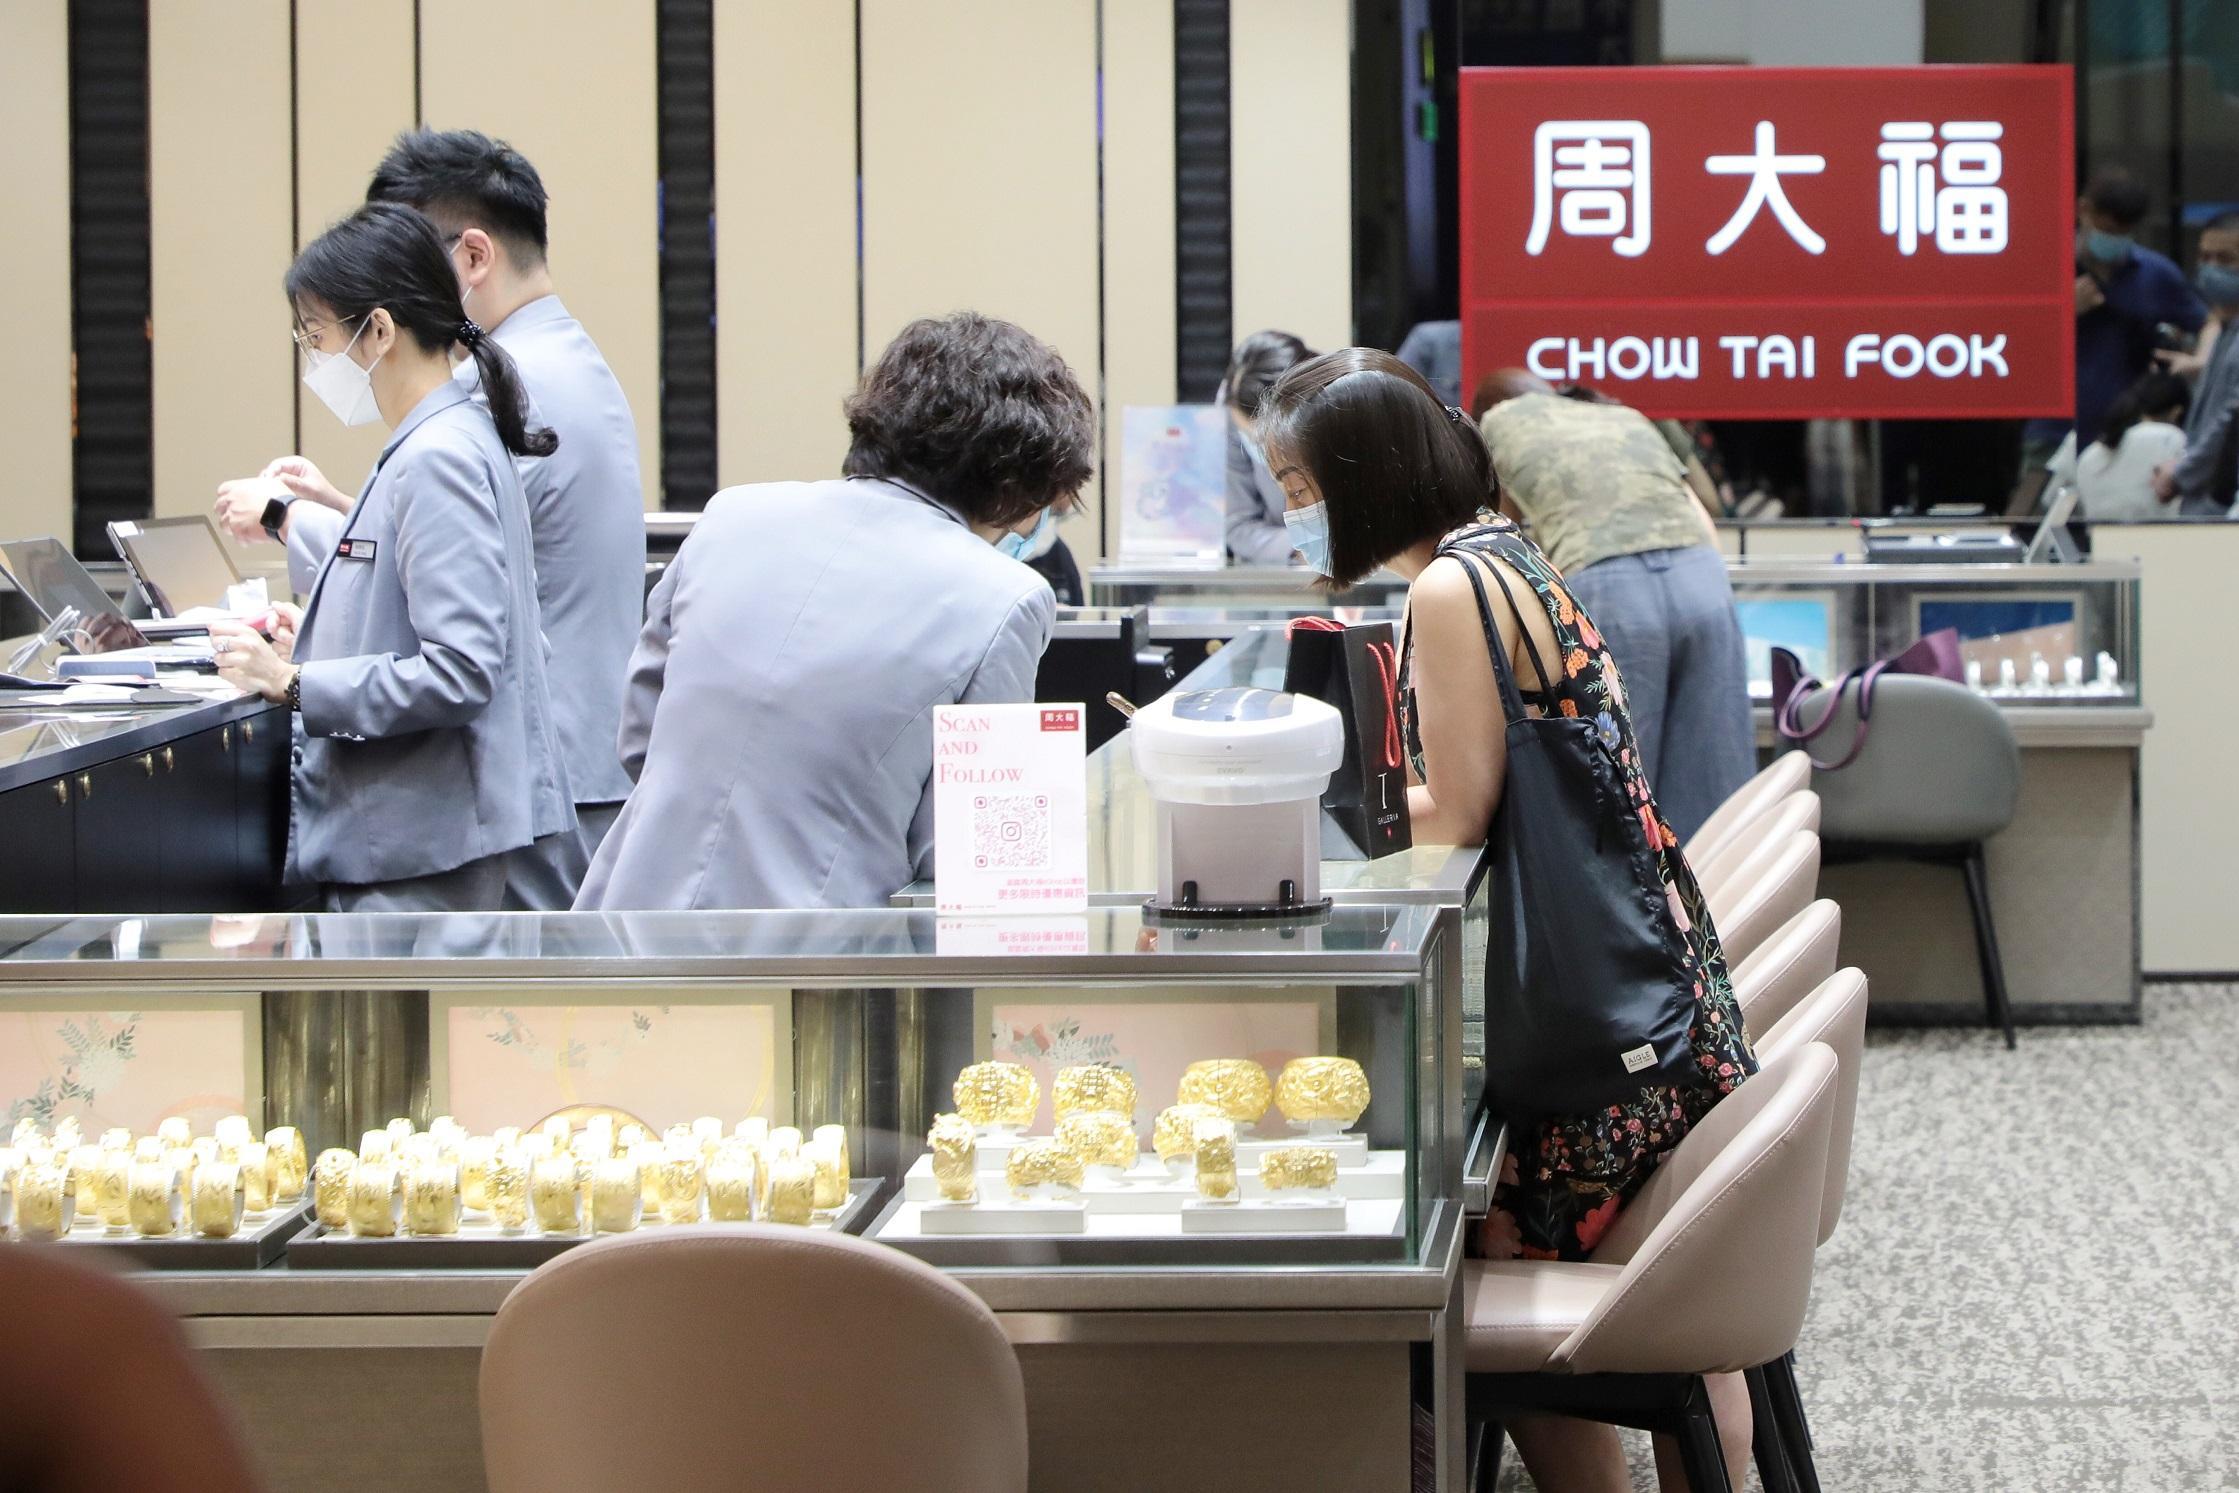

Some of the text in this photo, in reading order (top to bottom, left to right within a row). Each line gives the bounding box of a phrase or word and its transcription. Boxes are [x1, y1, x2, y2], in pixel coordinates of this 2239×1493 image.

[1525, 120, 2008, 257] 周大福
[1526, 333, 2009, 379] CHOW TAI FOOK
[1377, 772, 1388, 809] T
[1629, 1051, 1650, 1064] AIGLE
